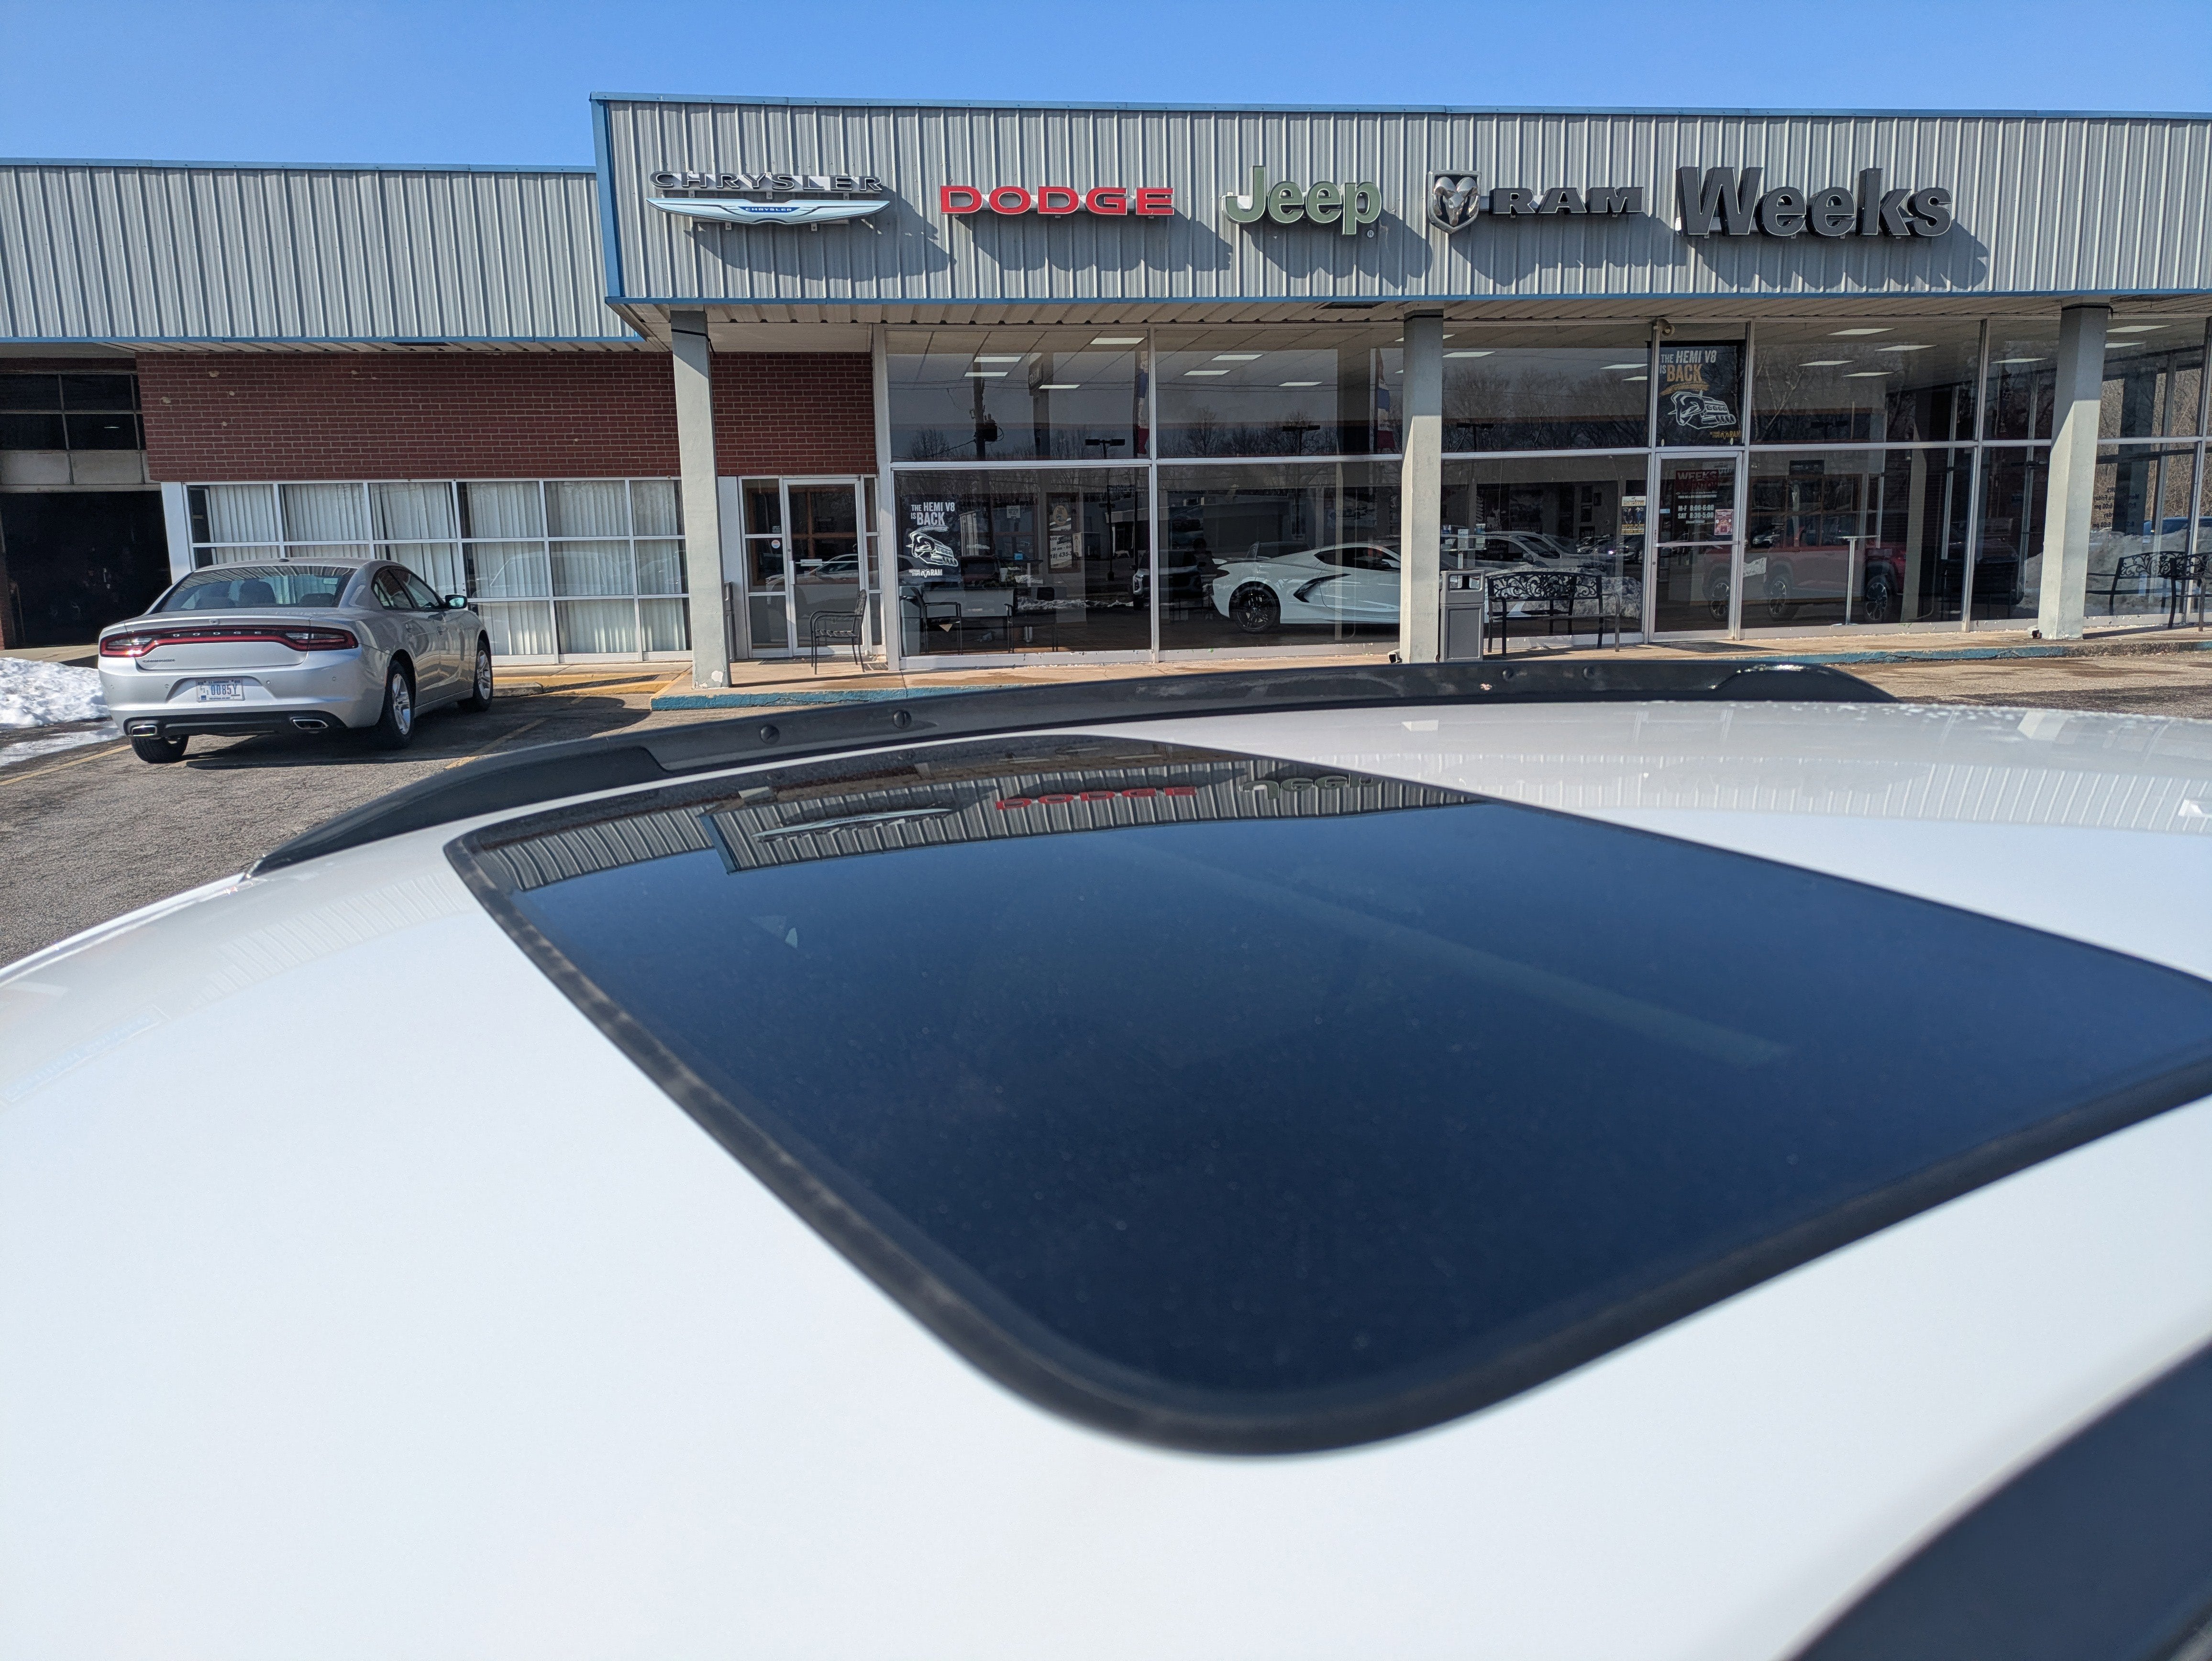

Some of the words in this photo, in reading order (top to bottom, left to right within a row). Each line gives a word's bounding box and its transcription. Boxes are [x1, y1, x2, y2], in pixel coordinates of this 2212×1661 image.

[650, 170, 883, 191] CHRYSLER
[940, 185, 1175, 215] DODGE
[1223, 165, 1381, 235] Jeep
[1488, 187, 1644, 214] RAM
[1675, 166, 1953, 237] Weeks
[1661, 354, 1674, 363] THE
[1676, 350, 1702, 363] HEMI
[1705, 350, 1716, 363] V8
[1659, 365, 1667, 374] IS
[1667, 364, 1703, 382] BACK
[923, 502, 944, 511] HEMI
[945, 502, 955, 511] V8
[917, 512, 945, 525] BACK
